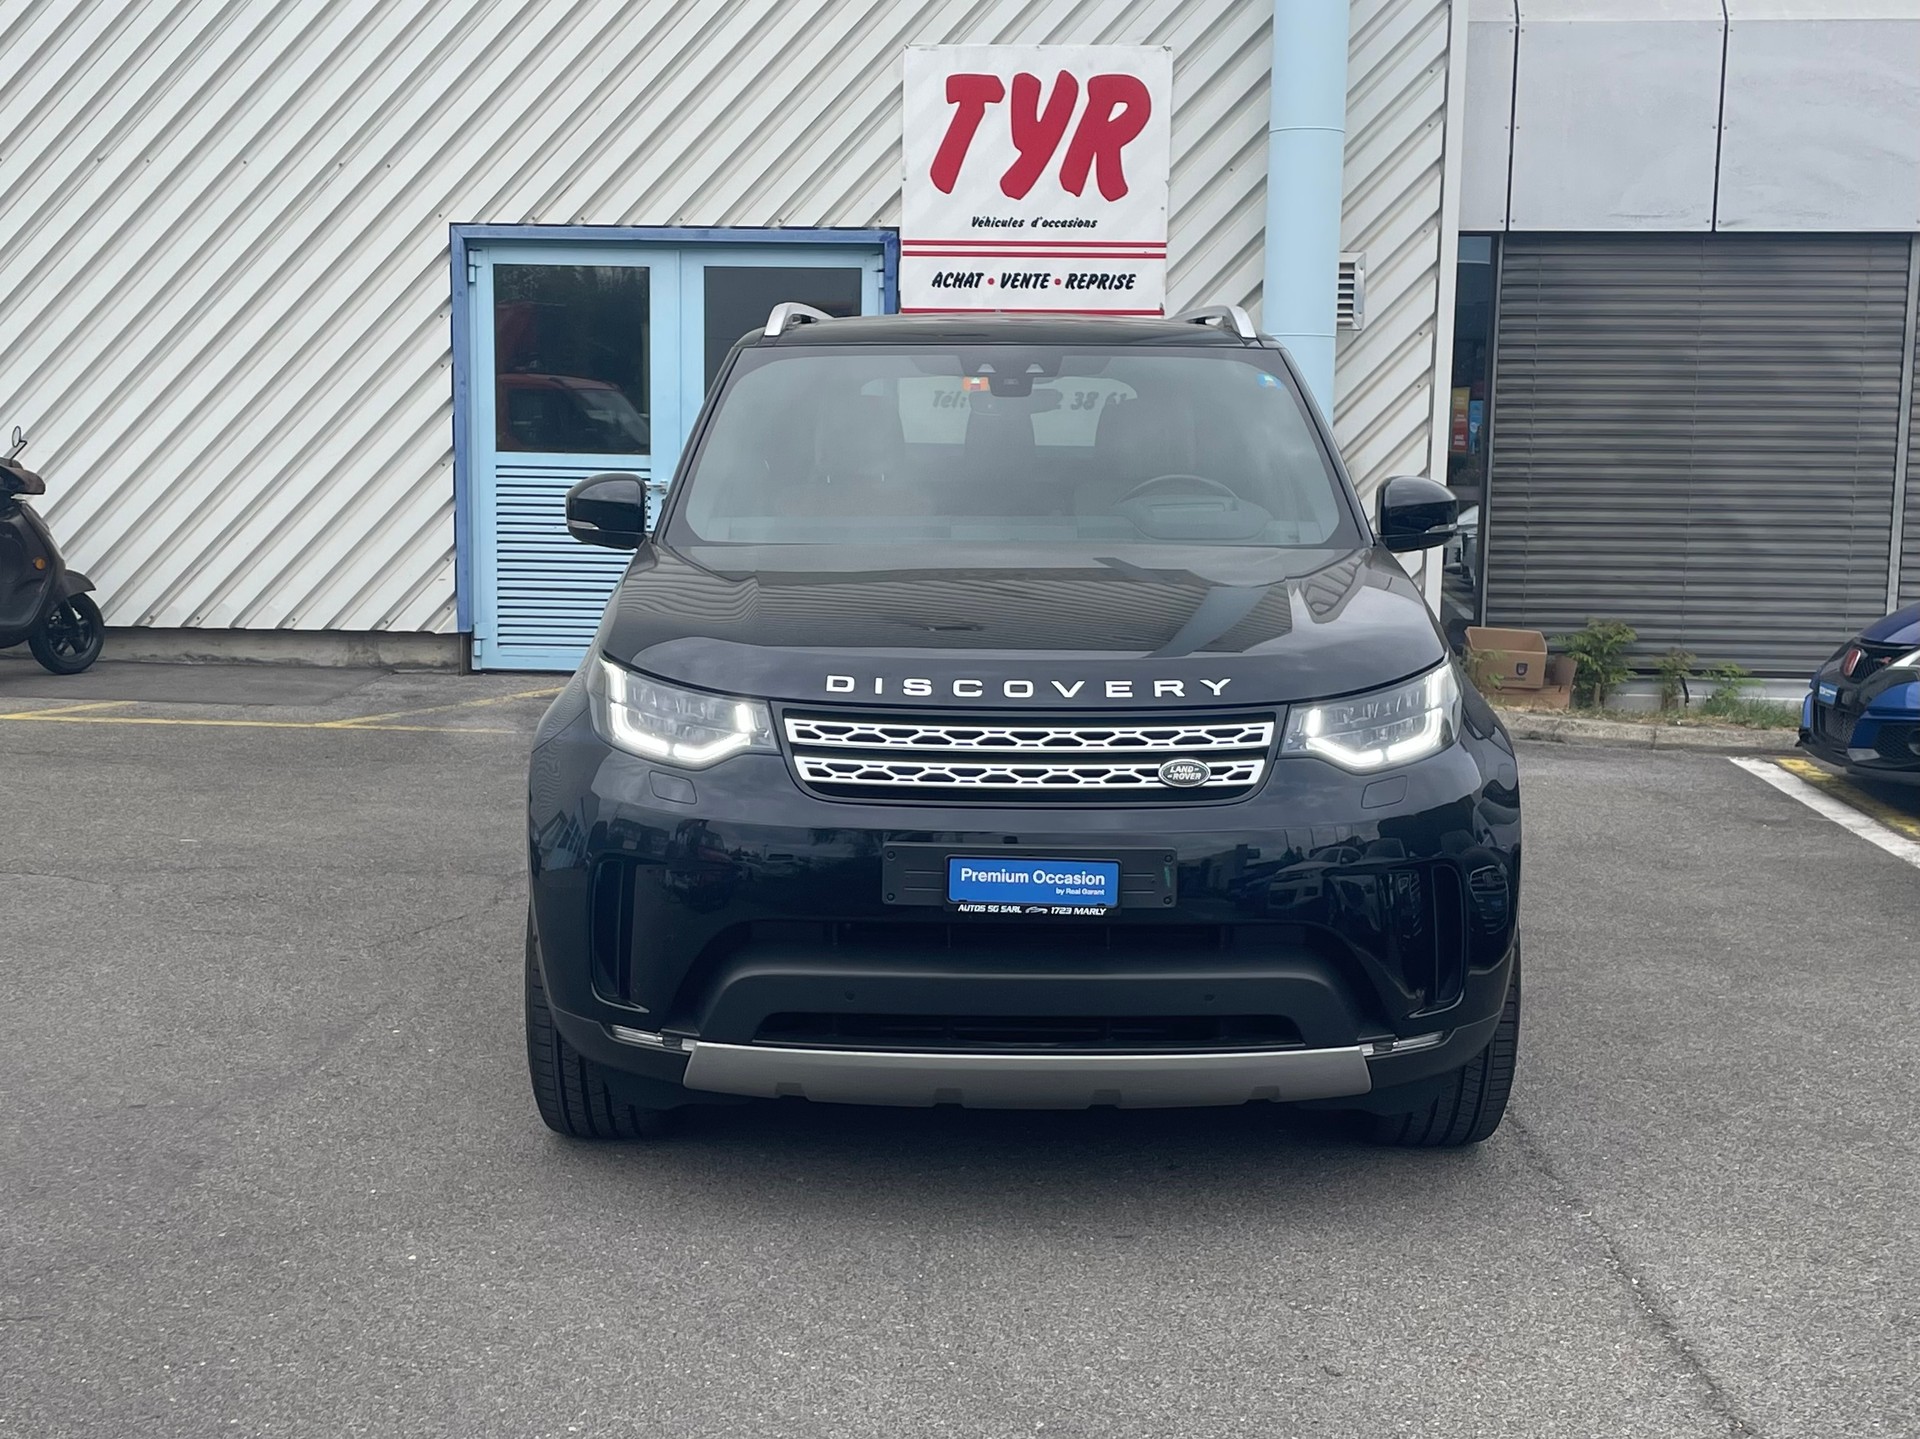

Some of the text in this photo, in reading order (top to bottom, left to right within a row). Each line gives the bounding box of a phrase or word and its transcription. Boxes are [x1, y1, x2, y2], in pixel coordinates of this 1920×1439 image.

[930, 70, 1152, 202] TYR
[971, 216, 1098, 228] Véhicules d'occasions
[931, 272, 1136, 290] ACHAT VENTE REPRISE
[1070, 391, 1100, 411] 38
[826, 675, 1231, 699] DISCOVERY
[1170, 765, 1194, 773] LAND
[1172, 772, 1202, 780] ROVER
[960, 868, 1105, 886] Premium Occasion
[1055, 887, 1065, 896] by
[957, 904, 986, 913] AUTOS
[1000, 905, 1022, 914] SARL
[1051, 906, 1073, 915] 1723
[1073, 907, 1107, 916] MARLY
